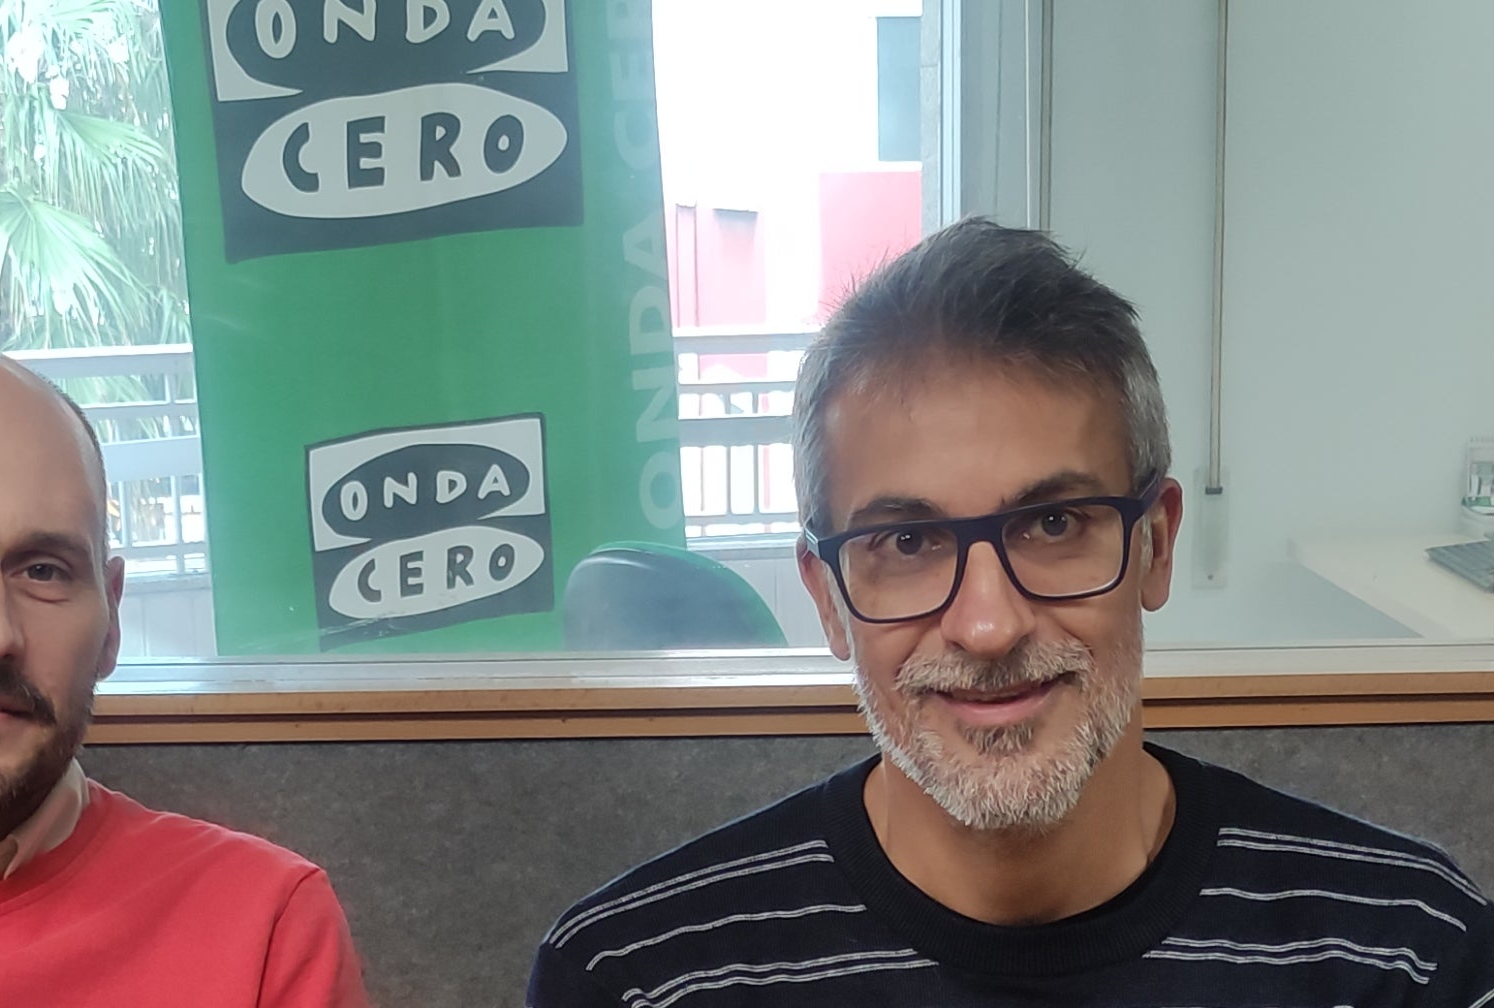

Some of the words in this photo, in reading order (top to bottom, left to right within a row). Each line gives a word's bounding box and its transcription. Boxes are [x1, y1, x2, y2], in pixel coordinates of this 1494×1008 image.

[254, 0, 516, 59] ONDA
[281, 111, 525, 194] CERO
[621, 217, 679, 531] ONDA
[339, 463, 511, 521] ONDA
[356, 542, 517, 604] CERO
